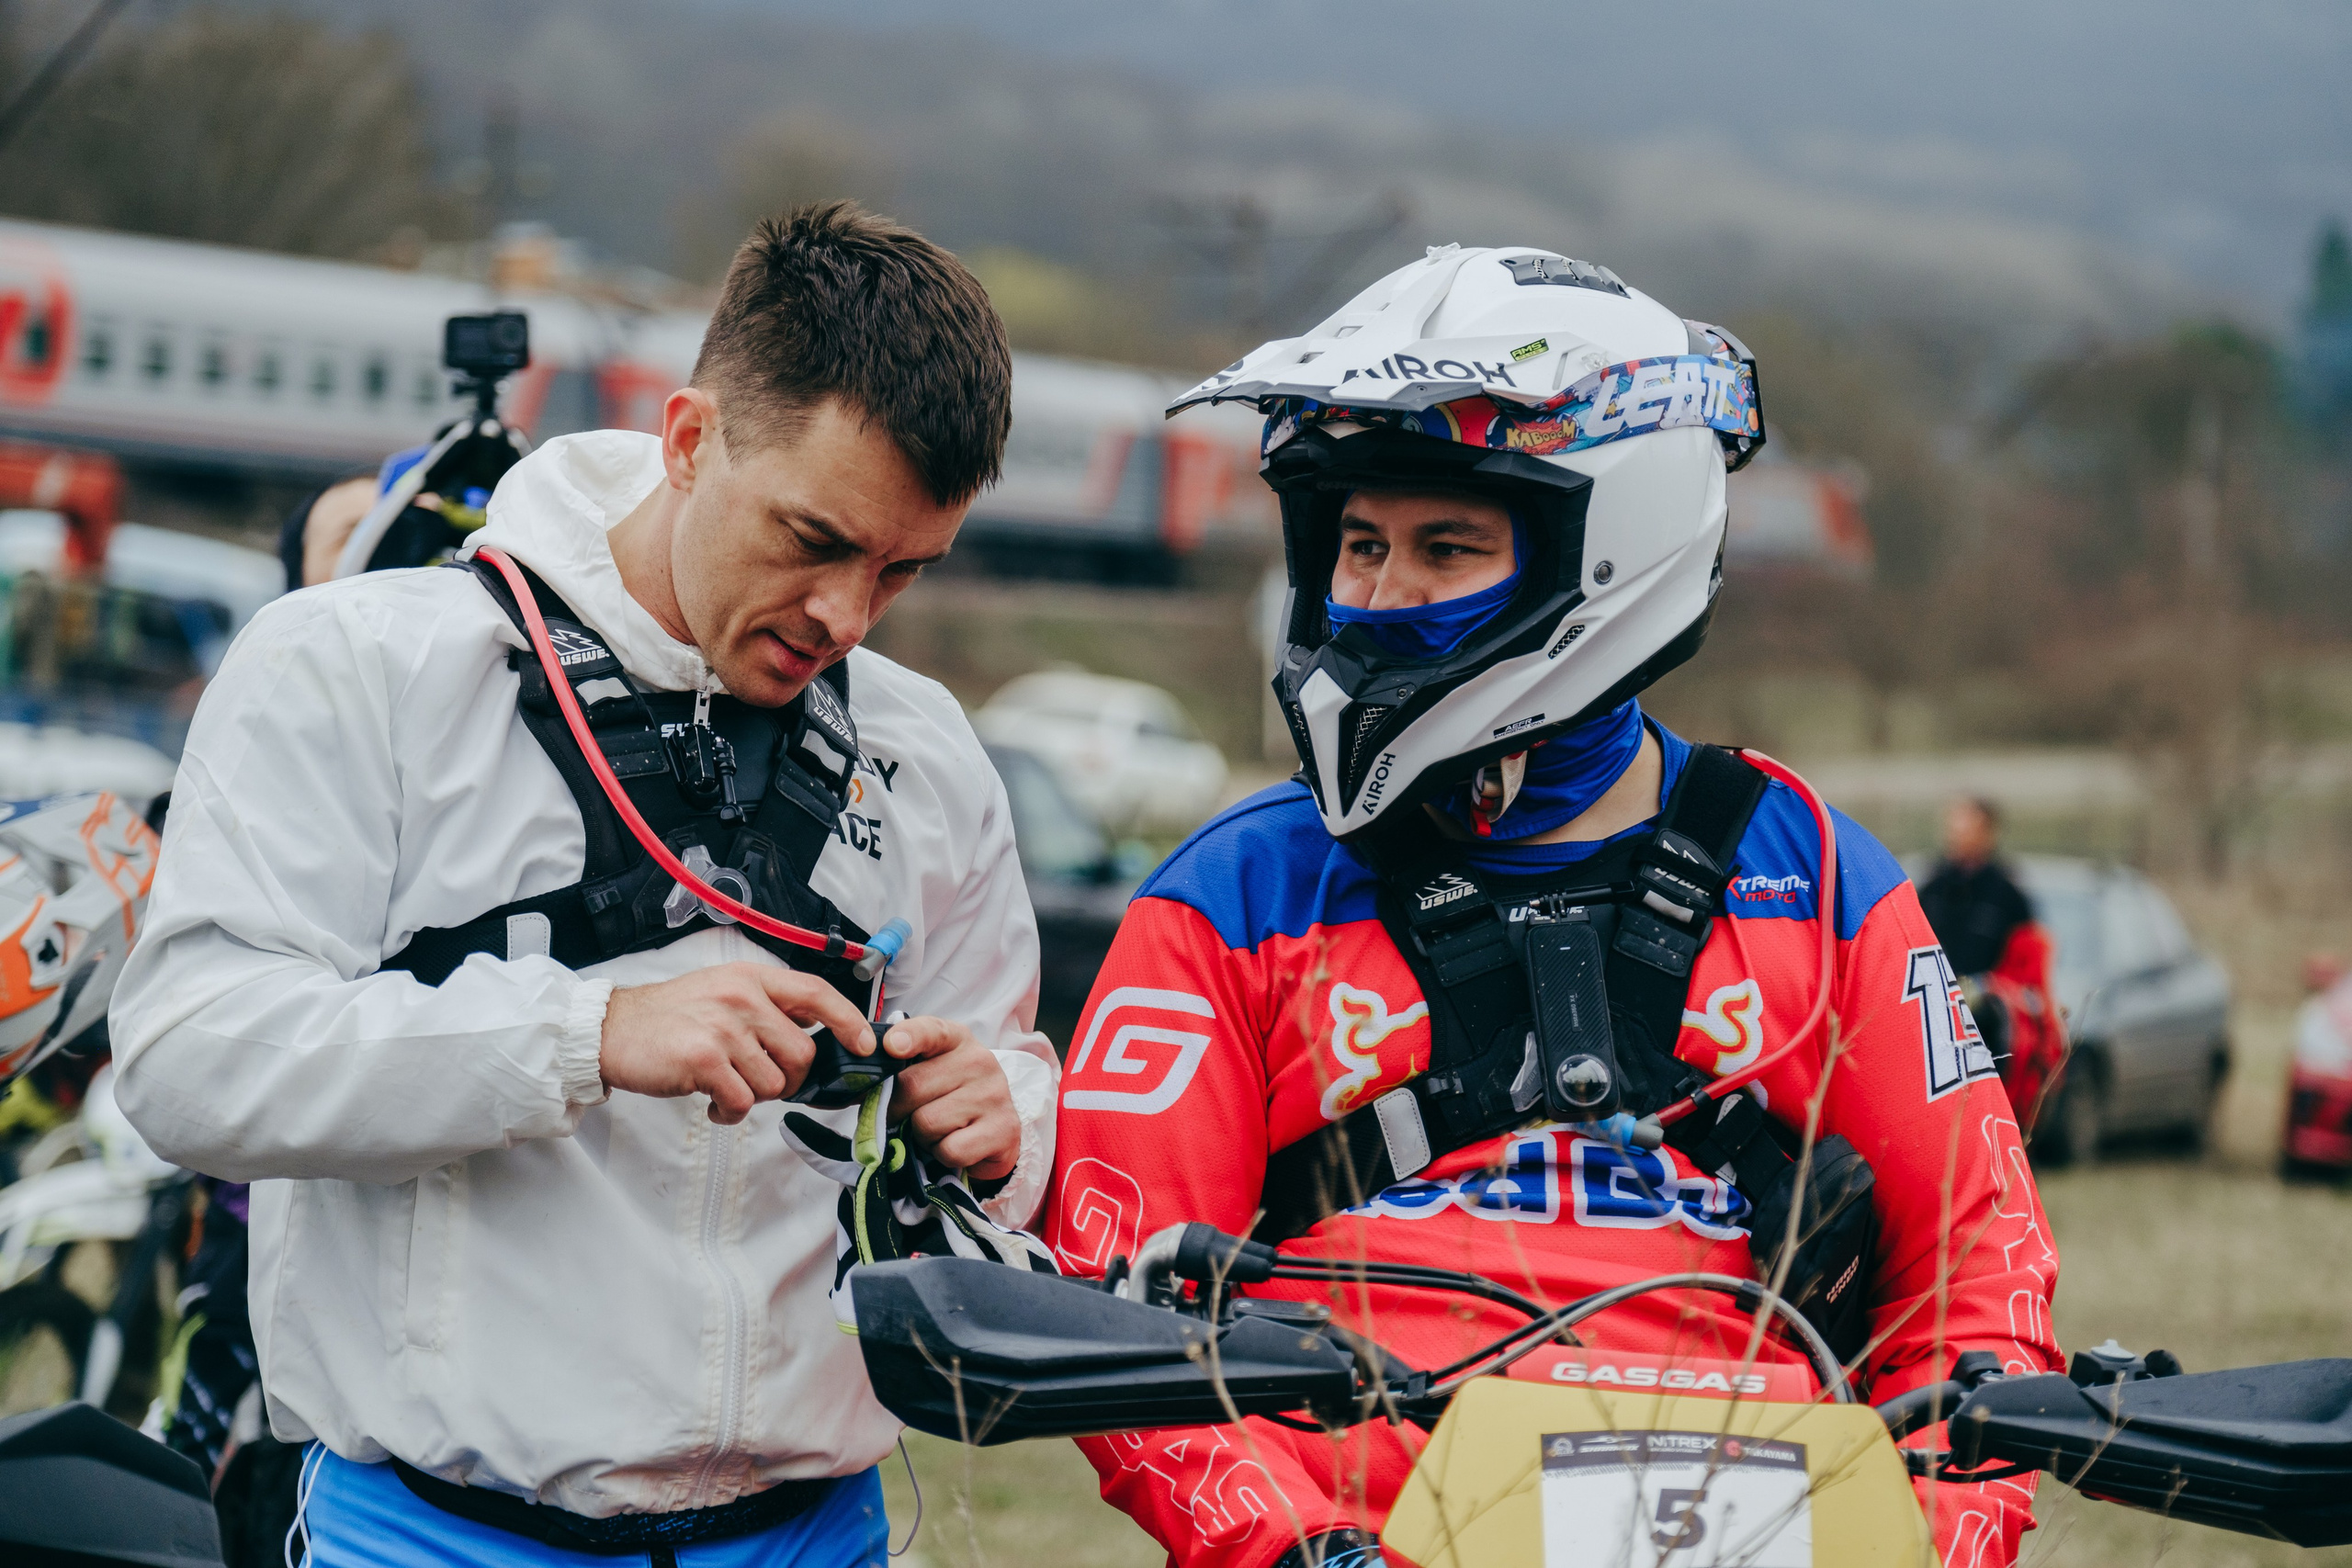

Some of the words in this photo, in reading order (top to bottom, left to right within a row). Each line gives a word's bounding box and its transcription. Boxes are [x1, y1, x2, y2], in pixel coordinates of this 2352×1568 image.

[1362, 752, 1396, 816] AIROH
[831, 812, 883, 861] ACE
[1745, 888, 1797, 903] MOTO
[1551, 1362, 1766, 1393] GASGAS
[1651, 1487, 1710, 1551] 5
